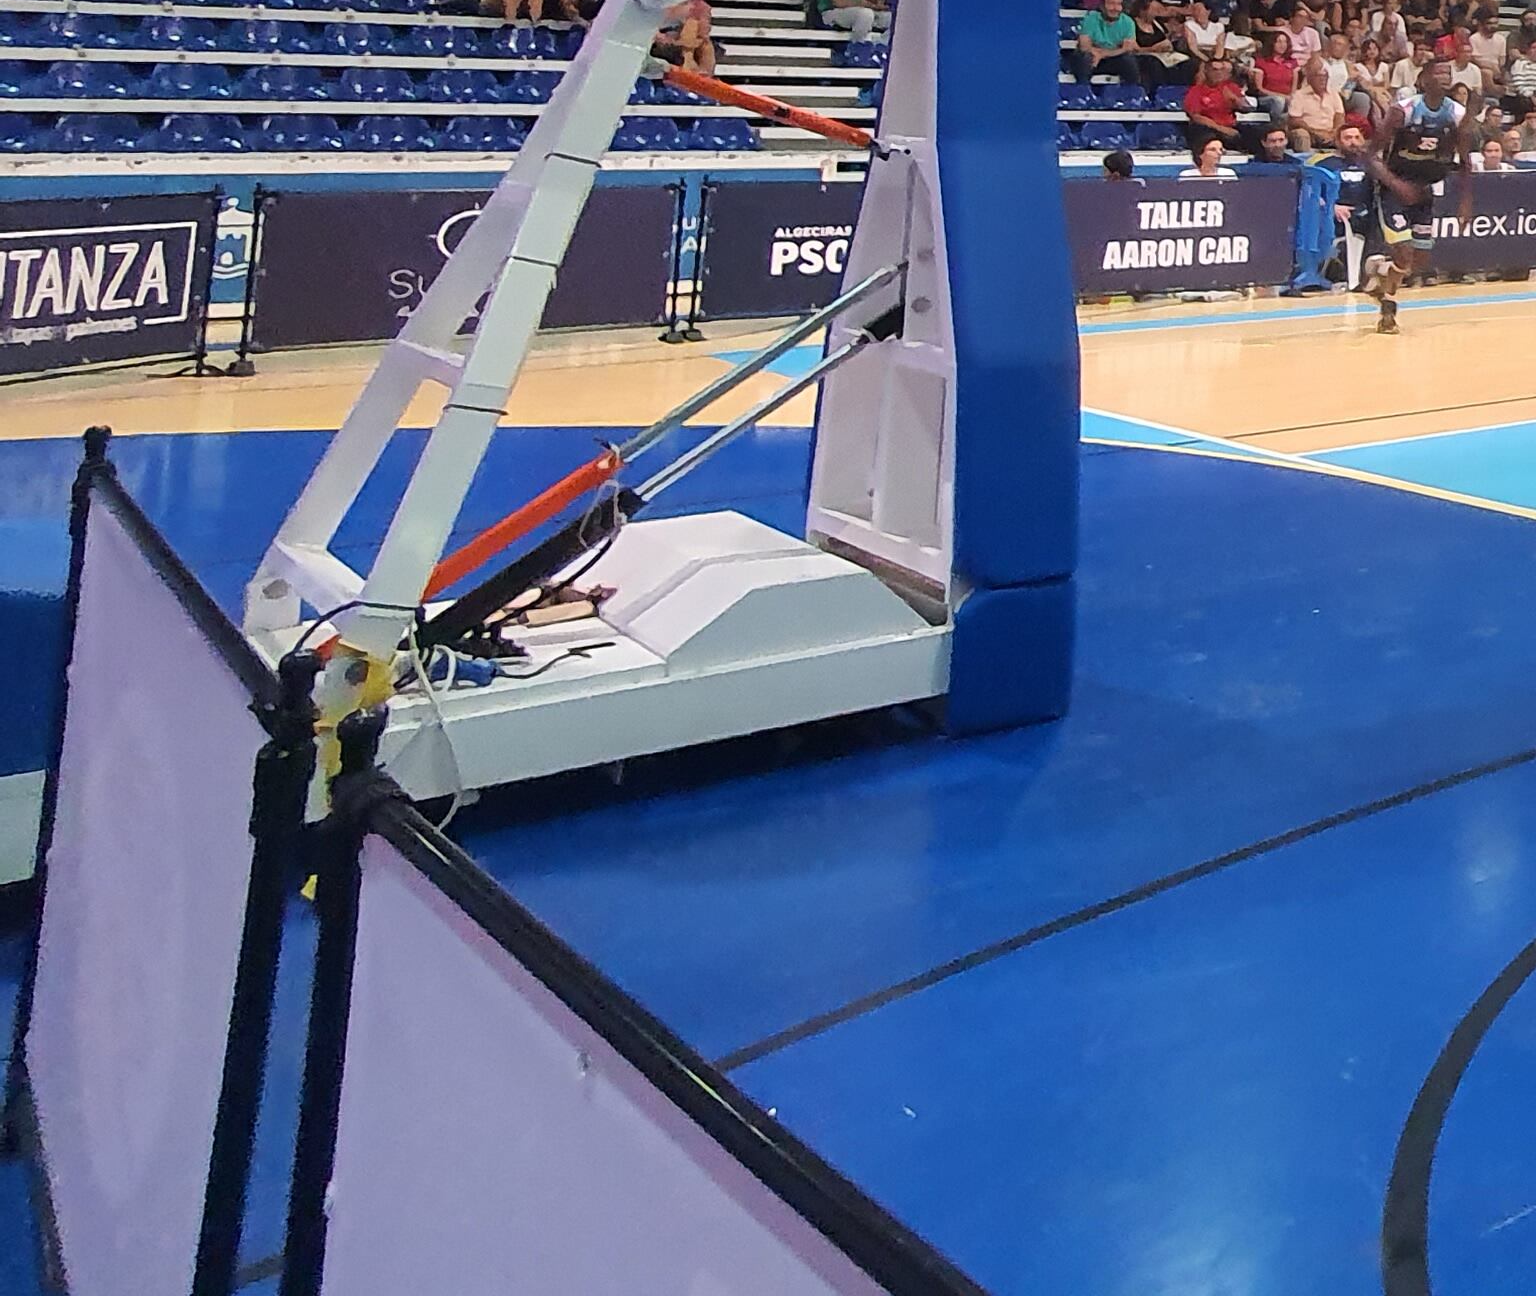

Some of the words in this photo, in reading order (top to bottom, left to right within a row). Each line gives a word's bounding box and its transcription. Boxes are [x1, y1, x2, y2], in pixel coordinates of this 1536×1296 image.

[1137, 200, 1224, 230] TALLER
[774, 224, 853, 239] ALGECIRAS
[1102, 238, 1194, 271] AARON
[1198, 235, 1250, 266] CAR
